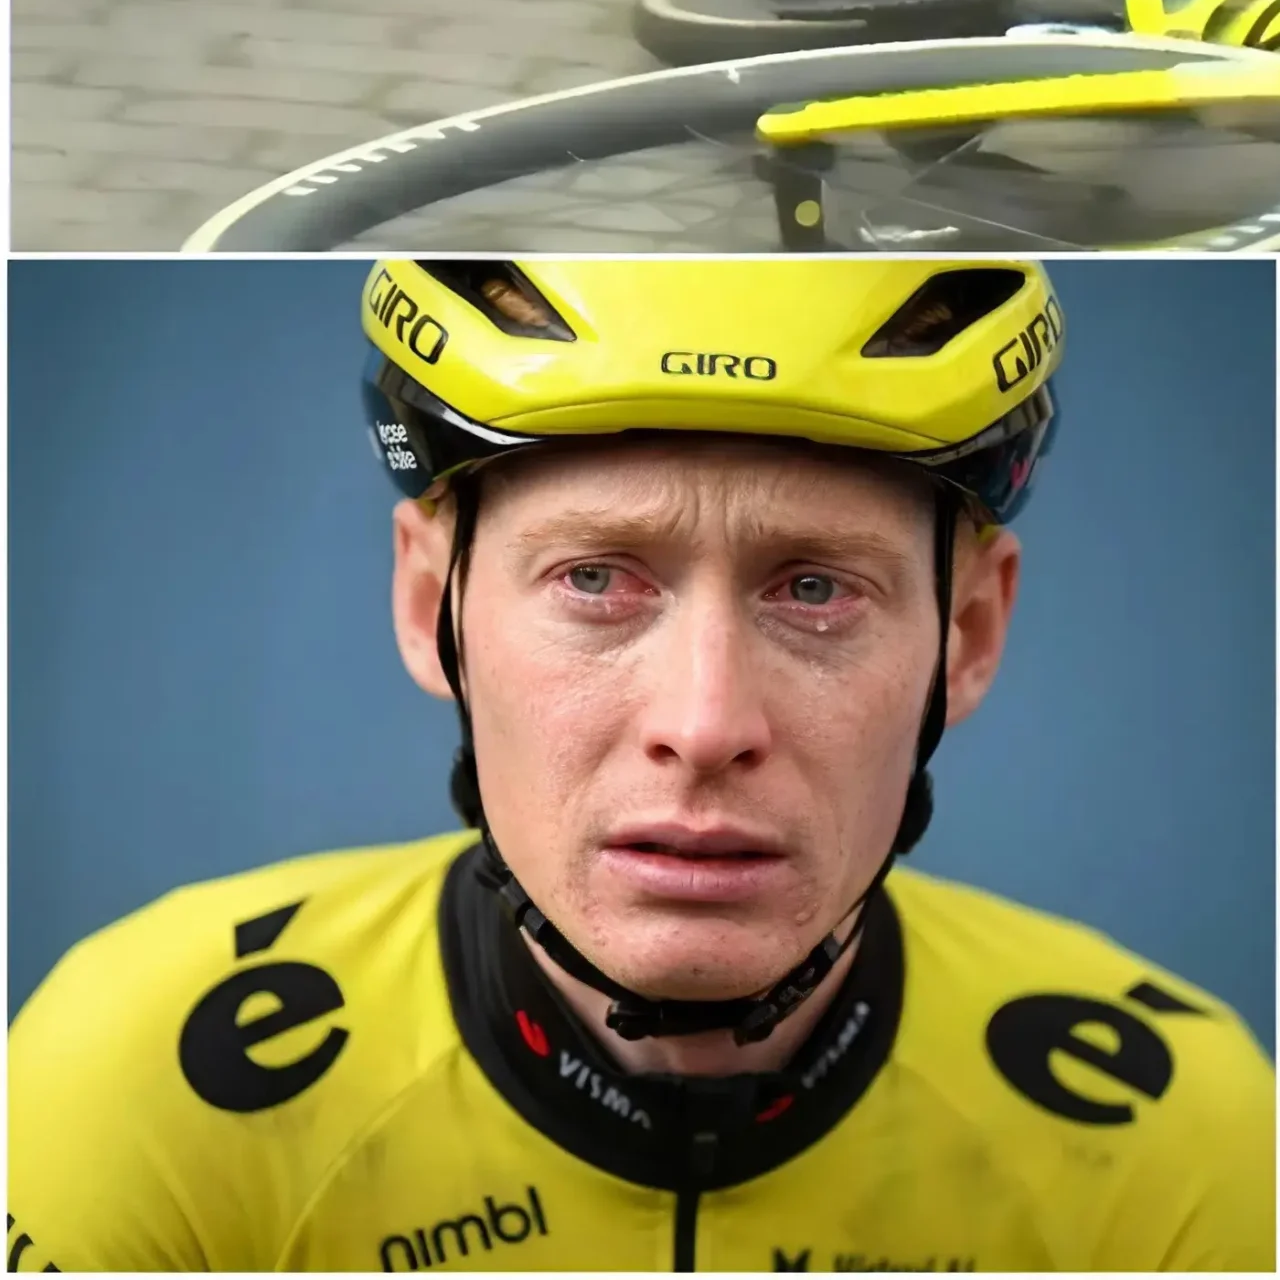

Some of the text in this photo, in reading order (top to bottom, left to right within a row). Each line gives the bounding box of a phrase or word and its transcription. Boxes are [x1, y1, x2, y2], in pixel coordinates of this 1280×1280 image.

[369, 268, 449, 365] GIRO
[992, 295, 1063, 393] GIRO
[661, 351, 776, 380] GIRO
[559, 1050, 652, 1131] VISMA
[379, 1186, 549, 1272] nimbl
